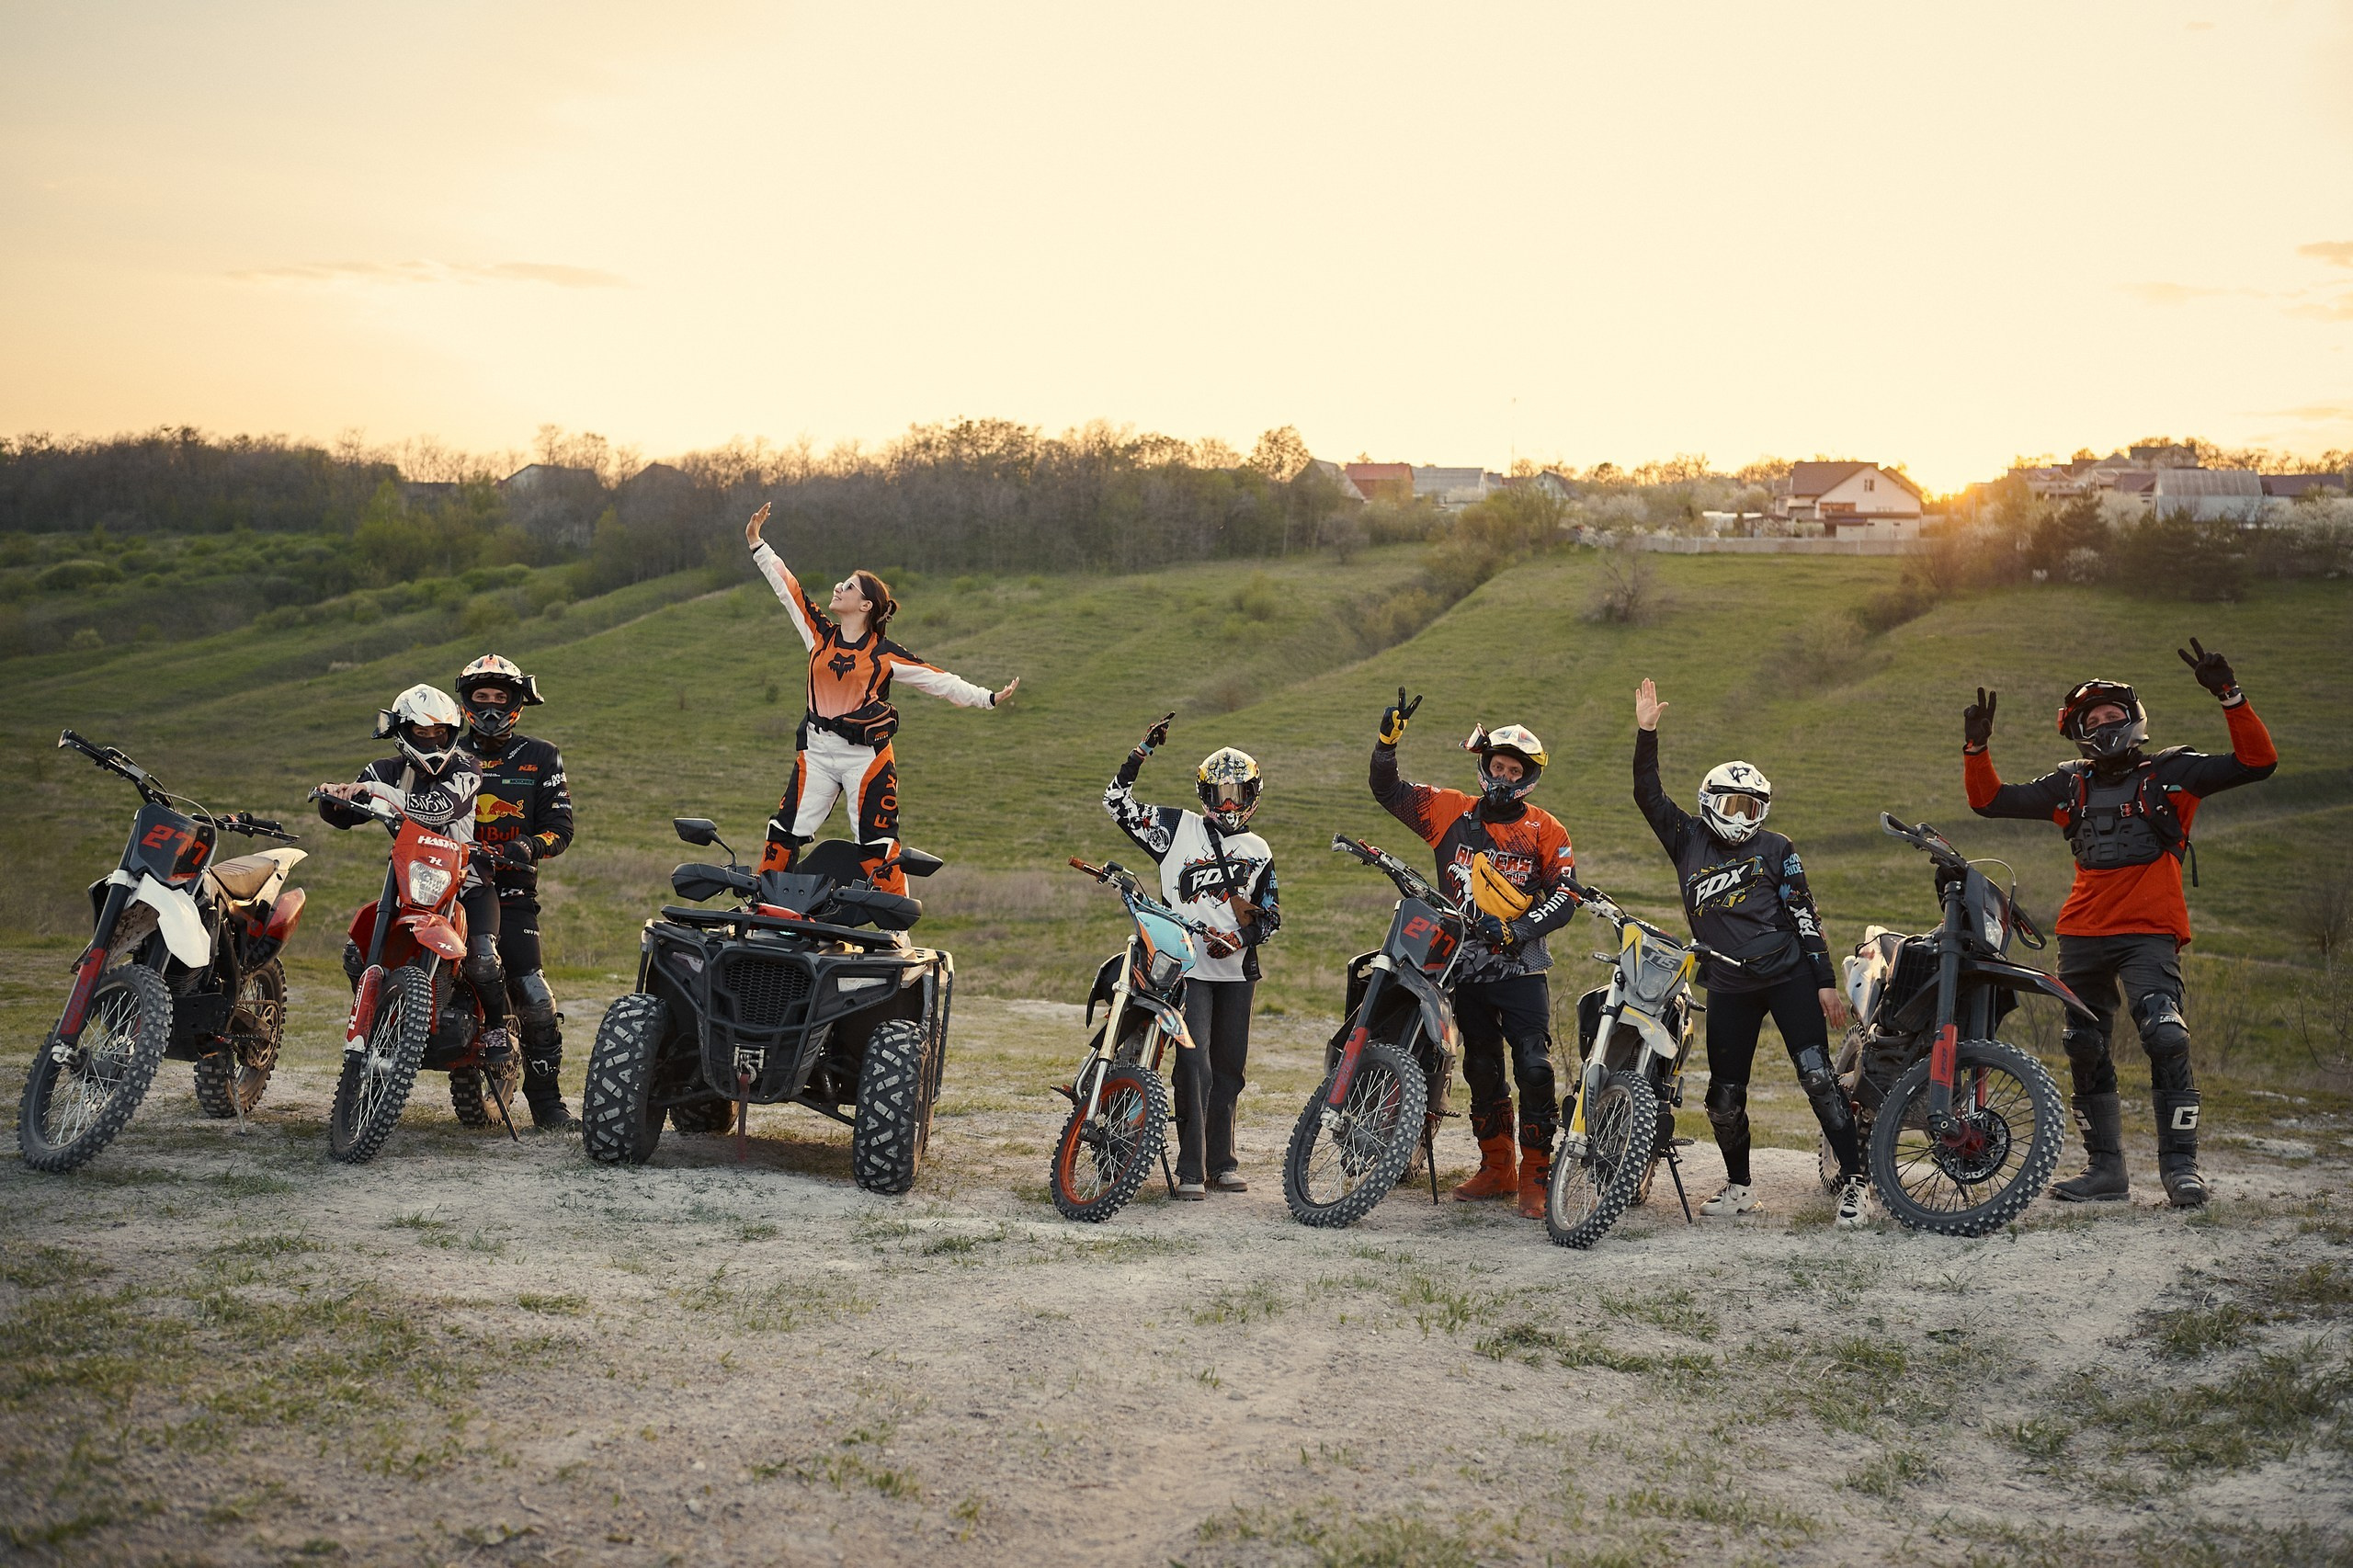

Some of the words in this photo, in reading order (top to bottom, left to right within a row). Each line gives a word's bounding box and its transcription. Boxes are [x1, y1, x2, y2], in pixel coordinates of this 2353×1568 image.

[874, 774, 898, 829] FOX
[141, 824, 210, 866] 277
[487, 826, 519, 841] Bull
[1189, 864, 1241, 892] FOX
[1694, 865, 1749, 907] FOX
[1403, 915, 1457, 958] 277
